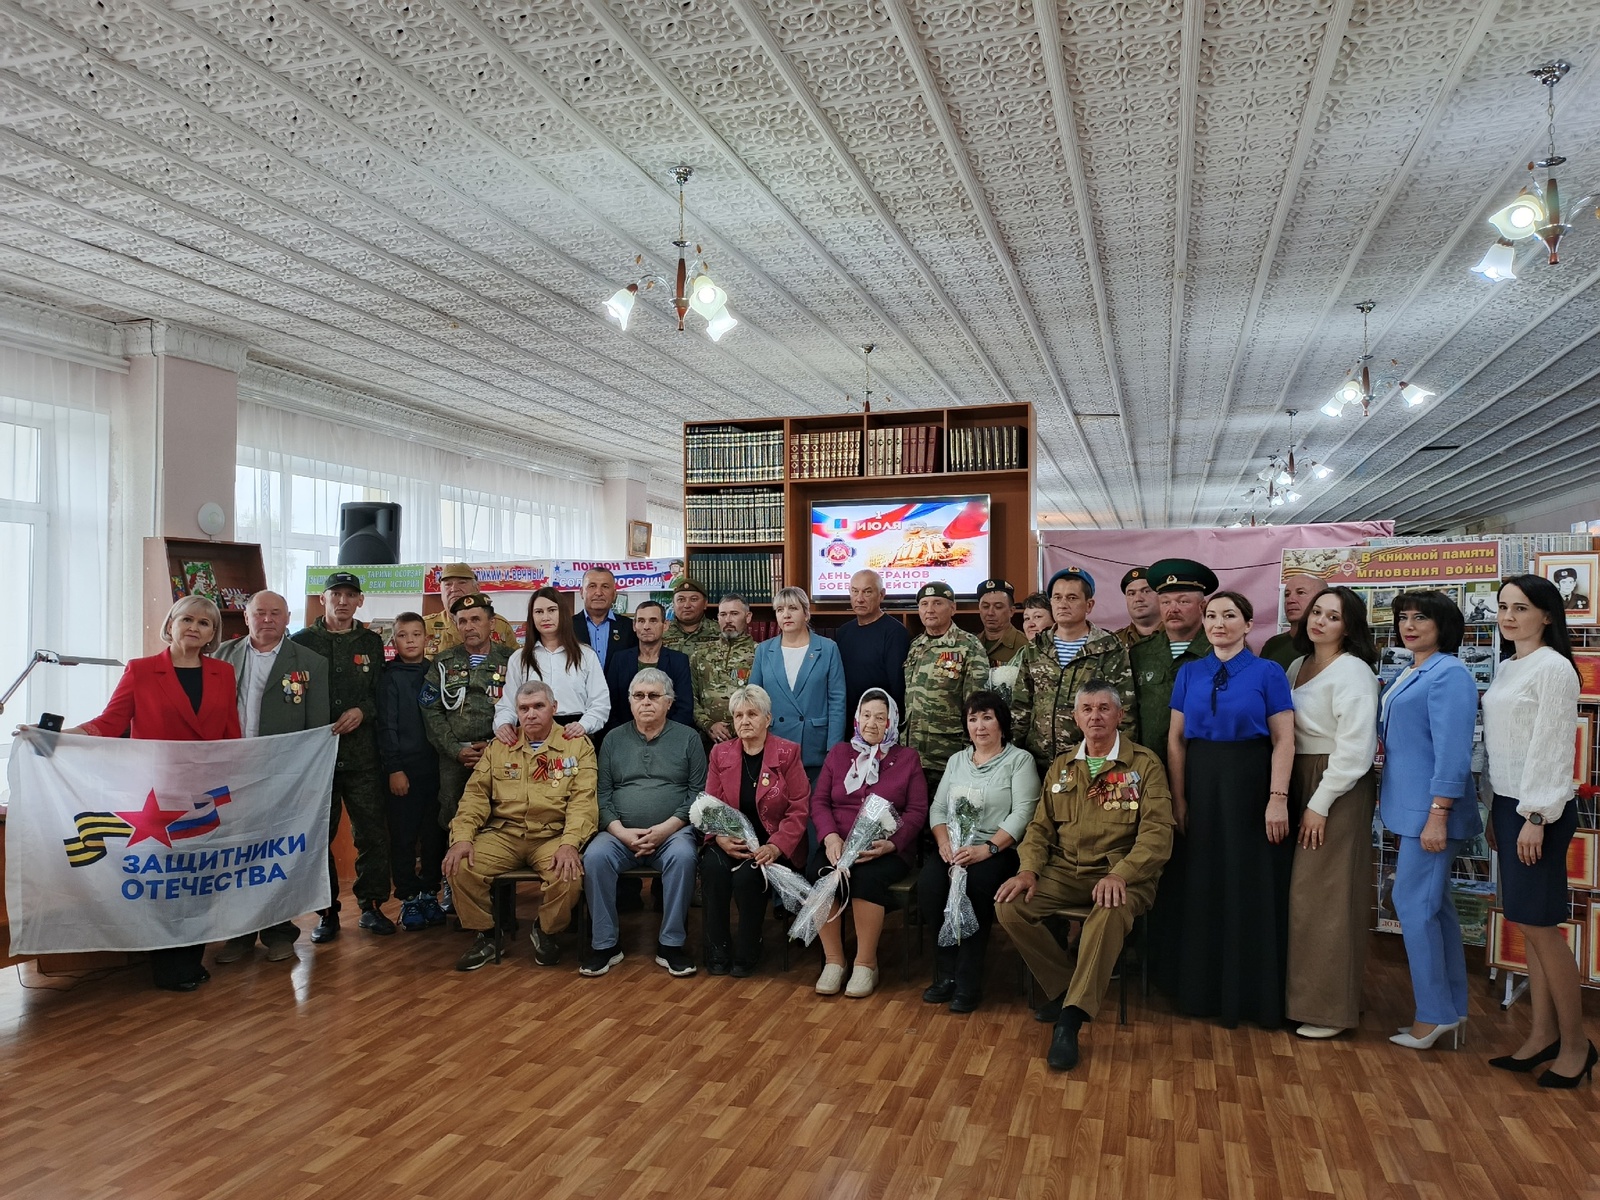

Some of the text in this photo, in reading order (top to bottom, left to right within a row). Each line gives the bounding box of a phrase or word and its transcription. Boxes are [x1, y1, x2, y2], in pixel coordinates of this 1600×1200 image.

[875, 511, 882, 519] 1
[856, 521, 902, 531] ИЮЛЯ
[1361, 548, 1495, 563] В книжной памяти
[622, 561, 658, 572] ТЕБЕ,
[1356, 562, 1497, 578] мгновения войны
[818, 570, 930, 581] ДЕНЬ ЕРАНОВ
[390, 580, 420, 588] ИСТОРИИ
[819, 580, 850, 590] БОЕВ
[122, 833, 306, 875] ЗАЩИТНИКИ
[121, 863, 288, 900] ОТЕЧЕСТВА
